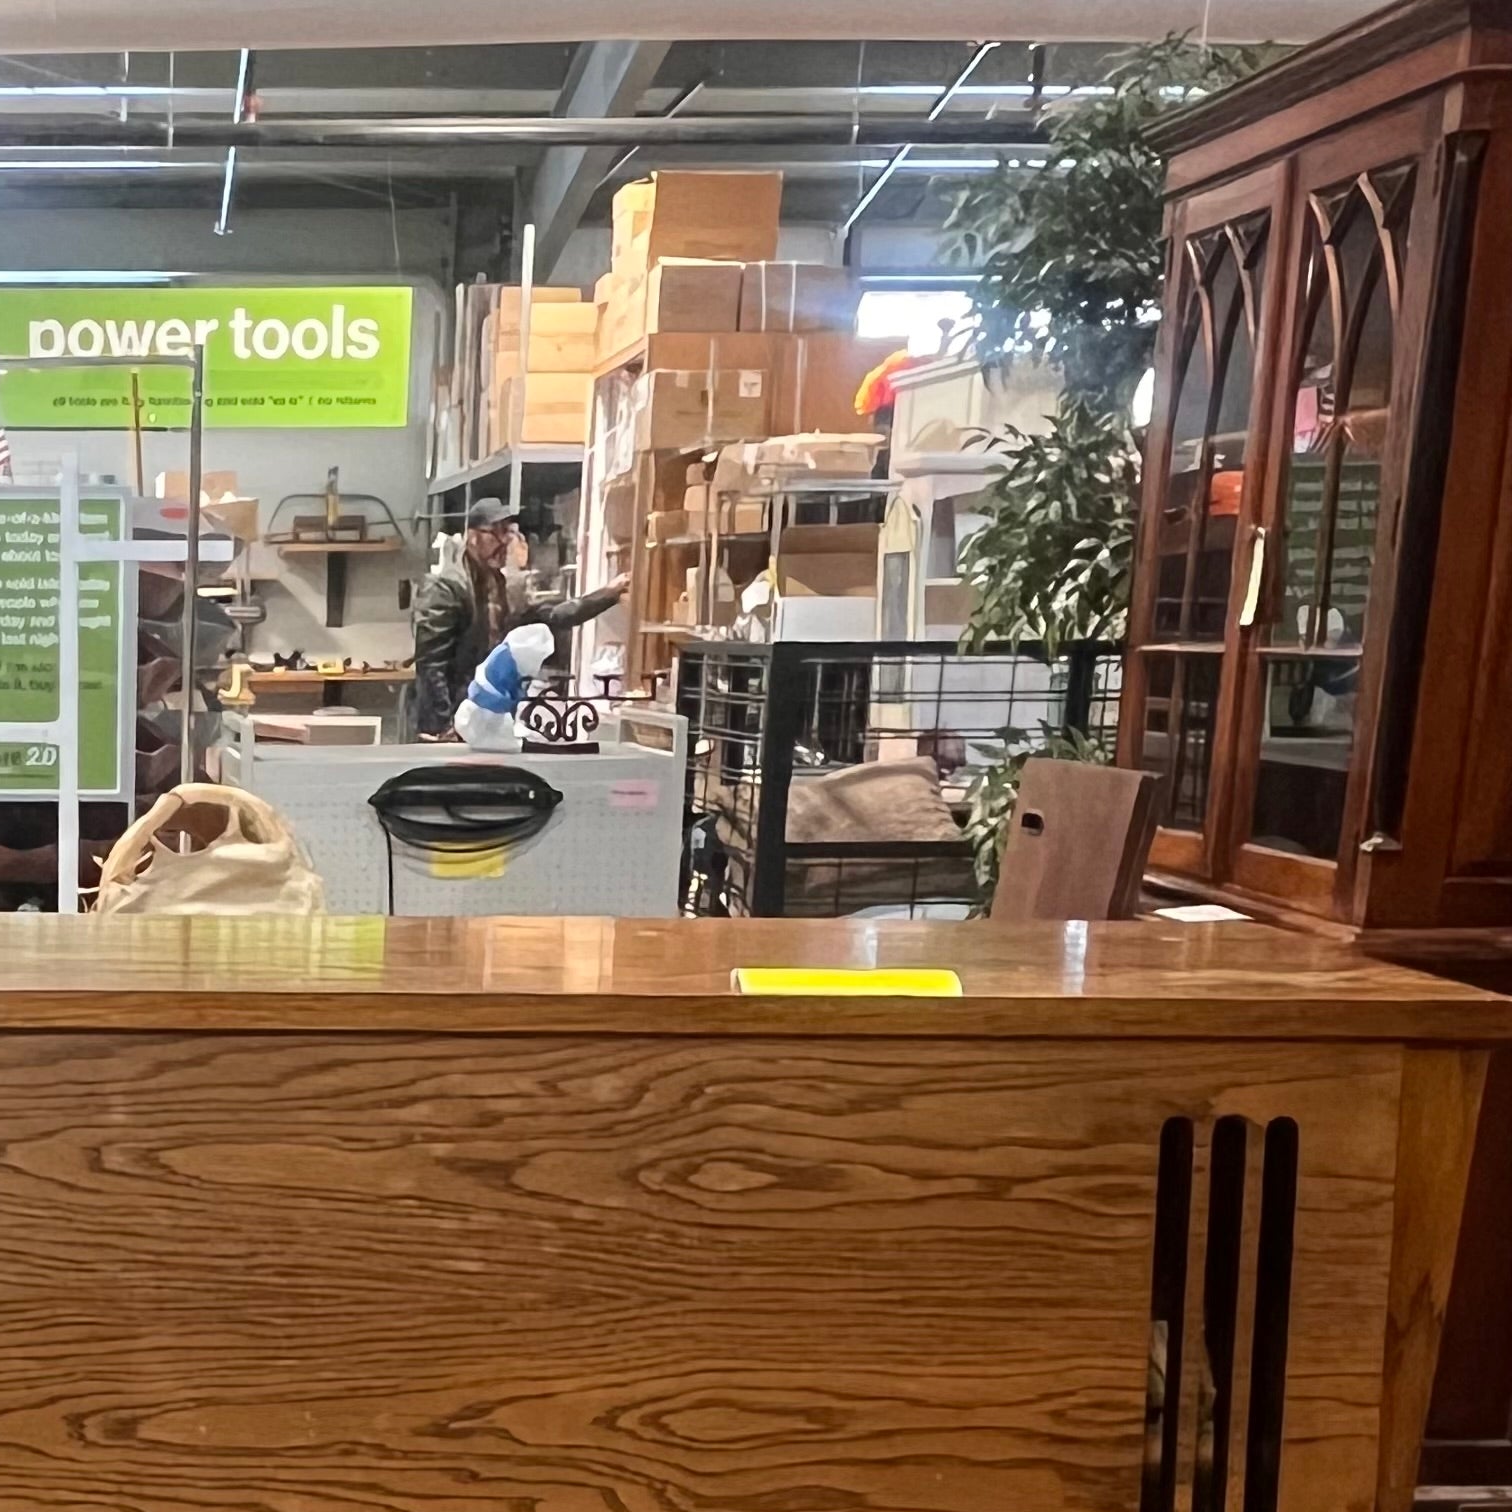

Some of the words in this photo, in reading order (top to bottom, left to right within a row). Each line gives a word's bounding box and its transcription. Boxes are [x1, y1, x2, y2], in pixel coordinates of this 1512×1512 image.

[29, 318, 218, 358] power
[229, 304, 381, 359] tools
[29, 632, 59, 647] nigh
